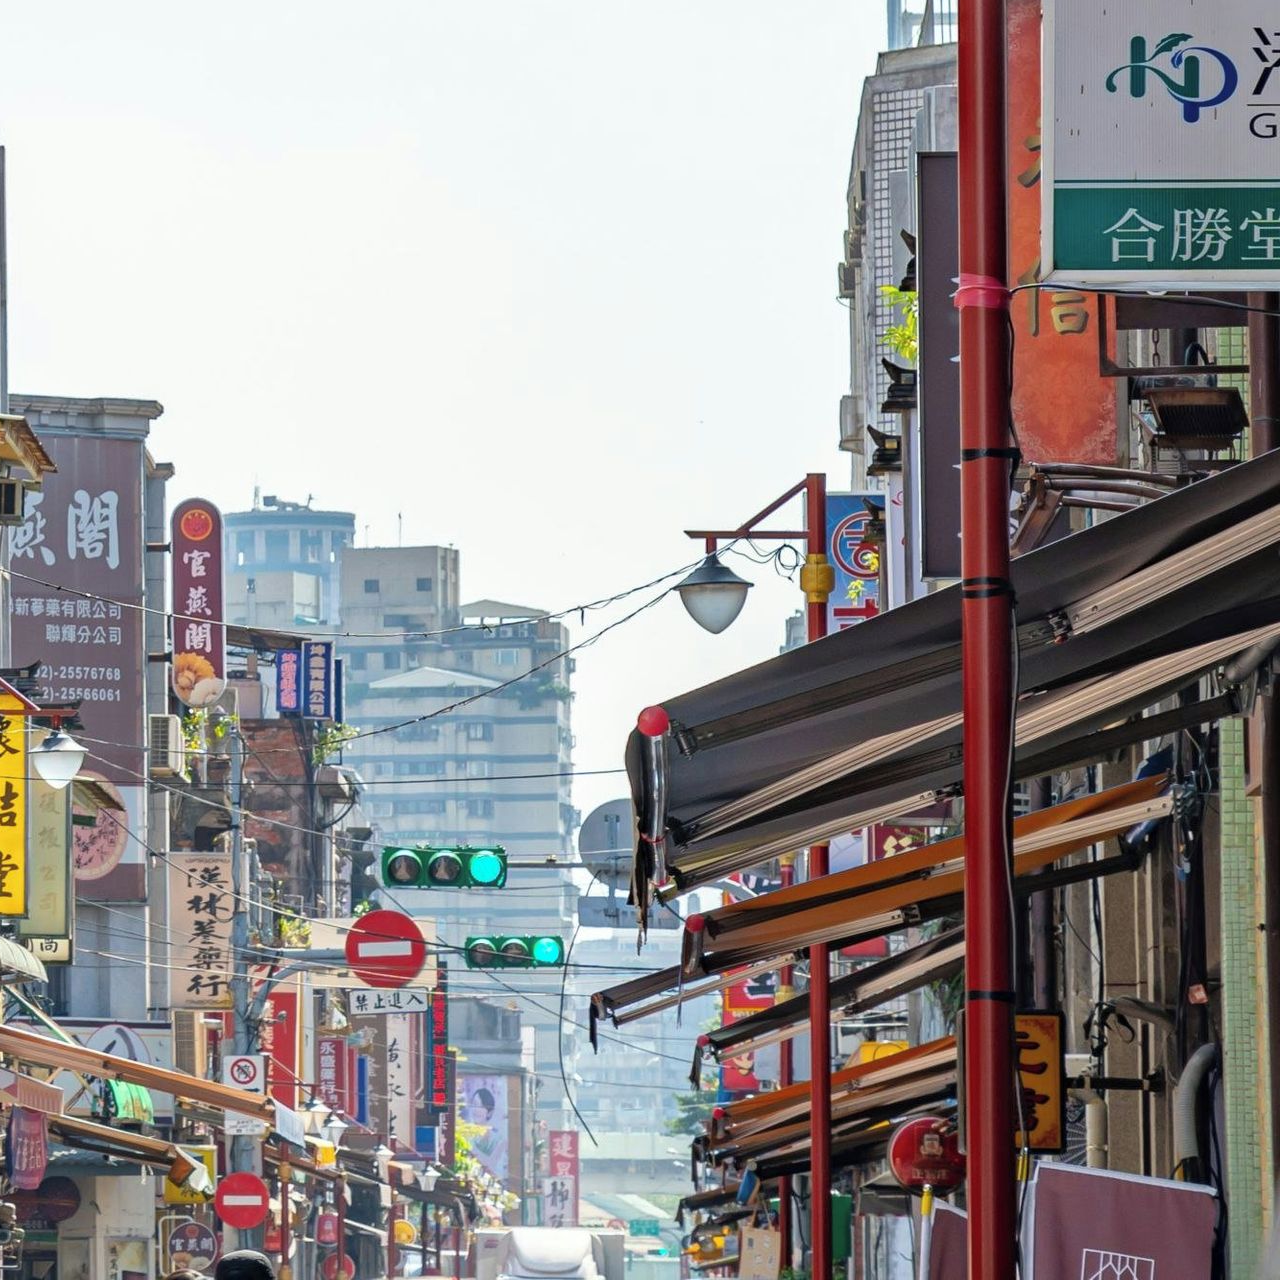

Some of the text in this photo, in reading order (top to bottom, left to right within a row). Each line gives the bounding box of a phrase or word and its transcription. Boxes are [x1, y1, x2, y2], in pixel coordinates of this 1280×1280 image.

[1103, 207, 1280, 263] 合勝堂
[9, 597, 122, 620] 新蔘藥有限公司
[182, 549, 213, 654] 官燕閣
[45, 624, 122, 645] 聯輝分公司
[32, 686, 122, 702] 2)-25566061
[355, 990, 424, 1012] 禁止進入
